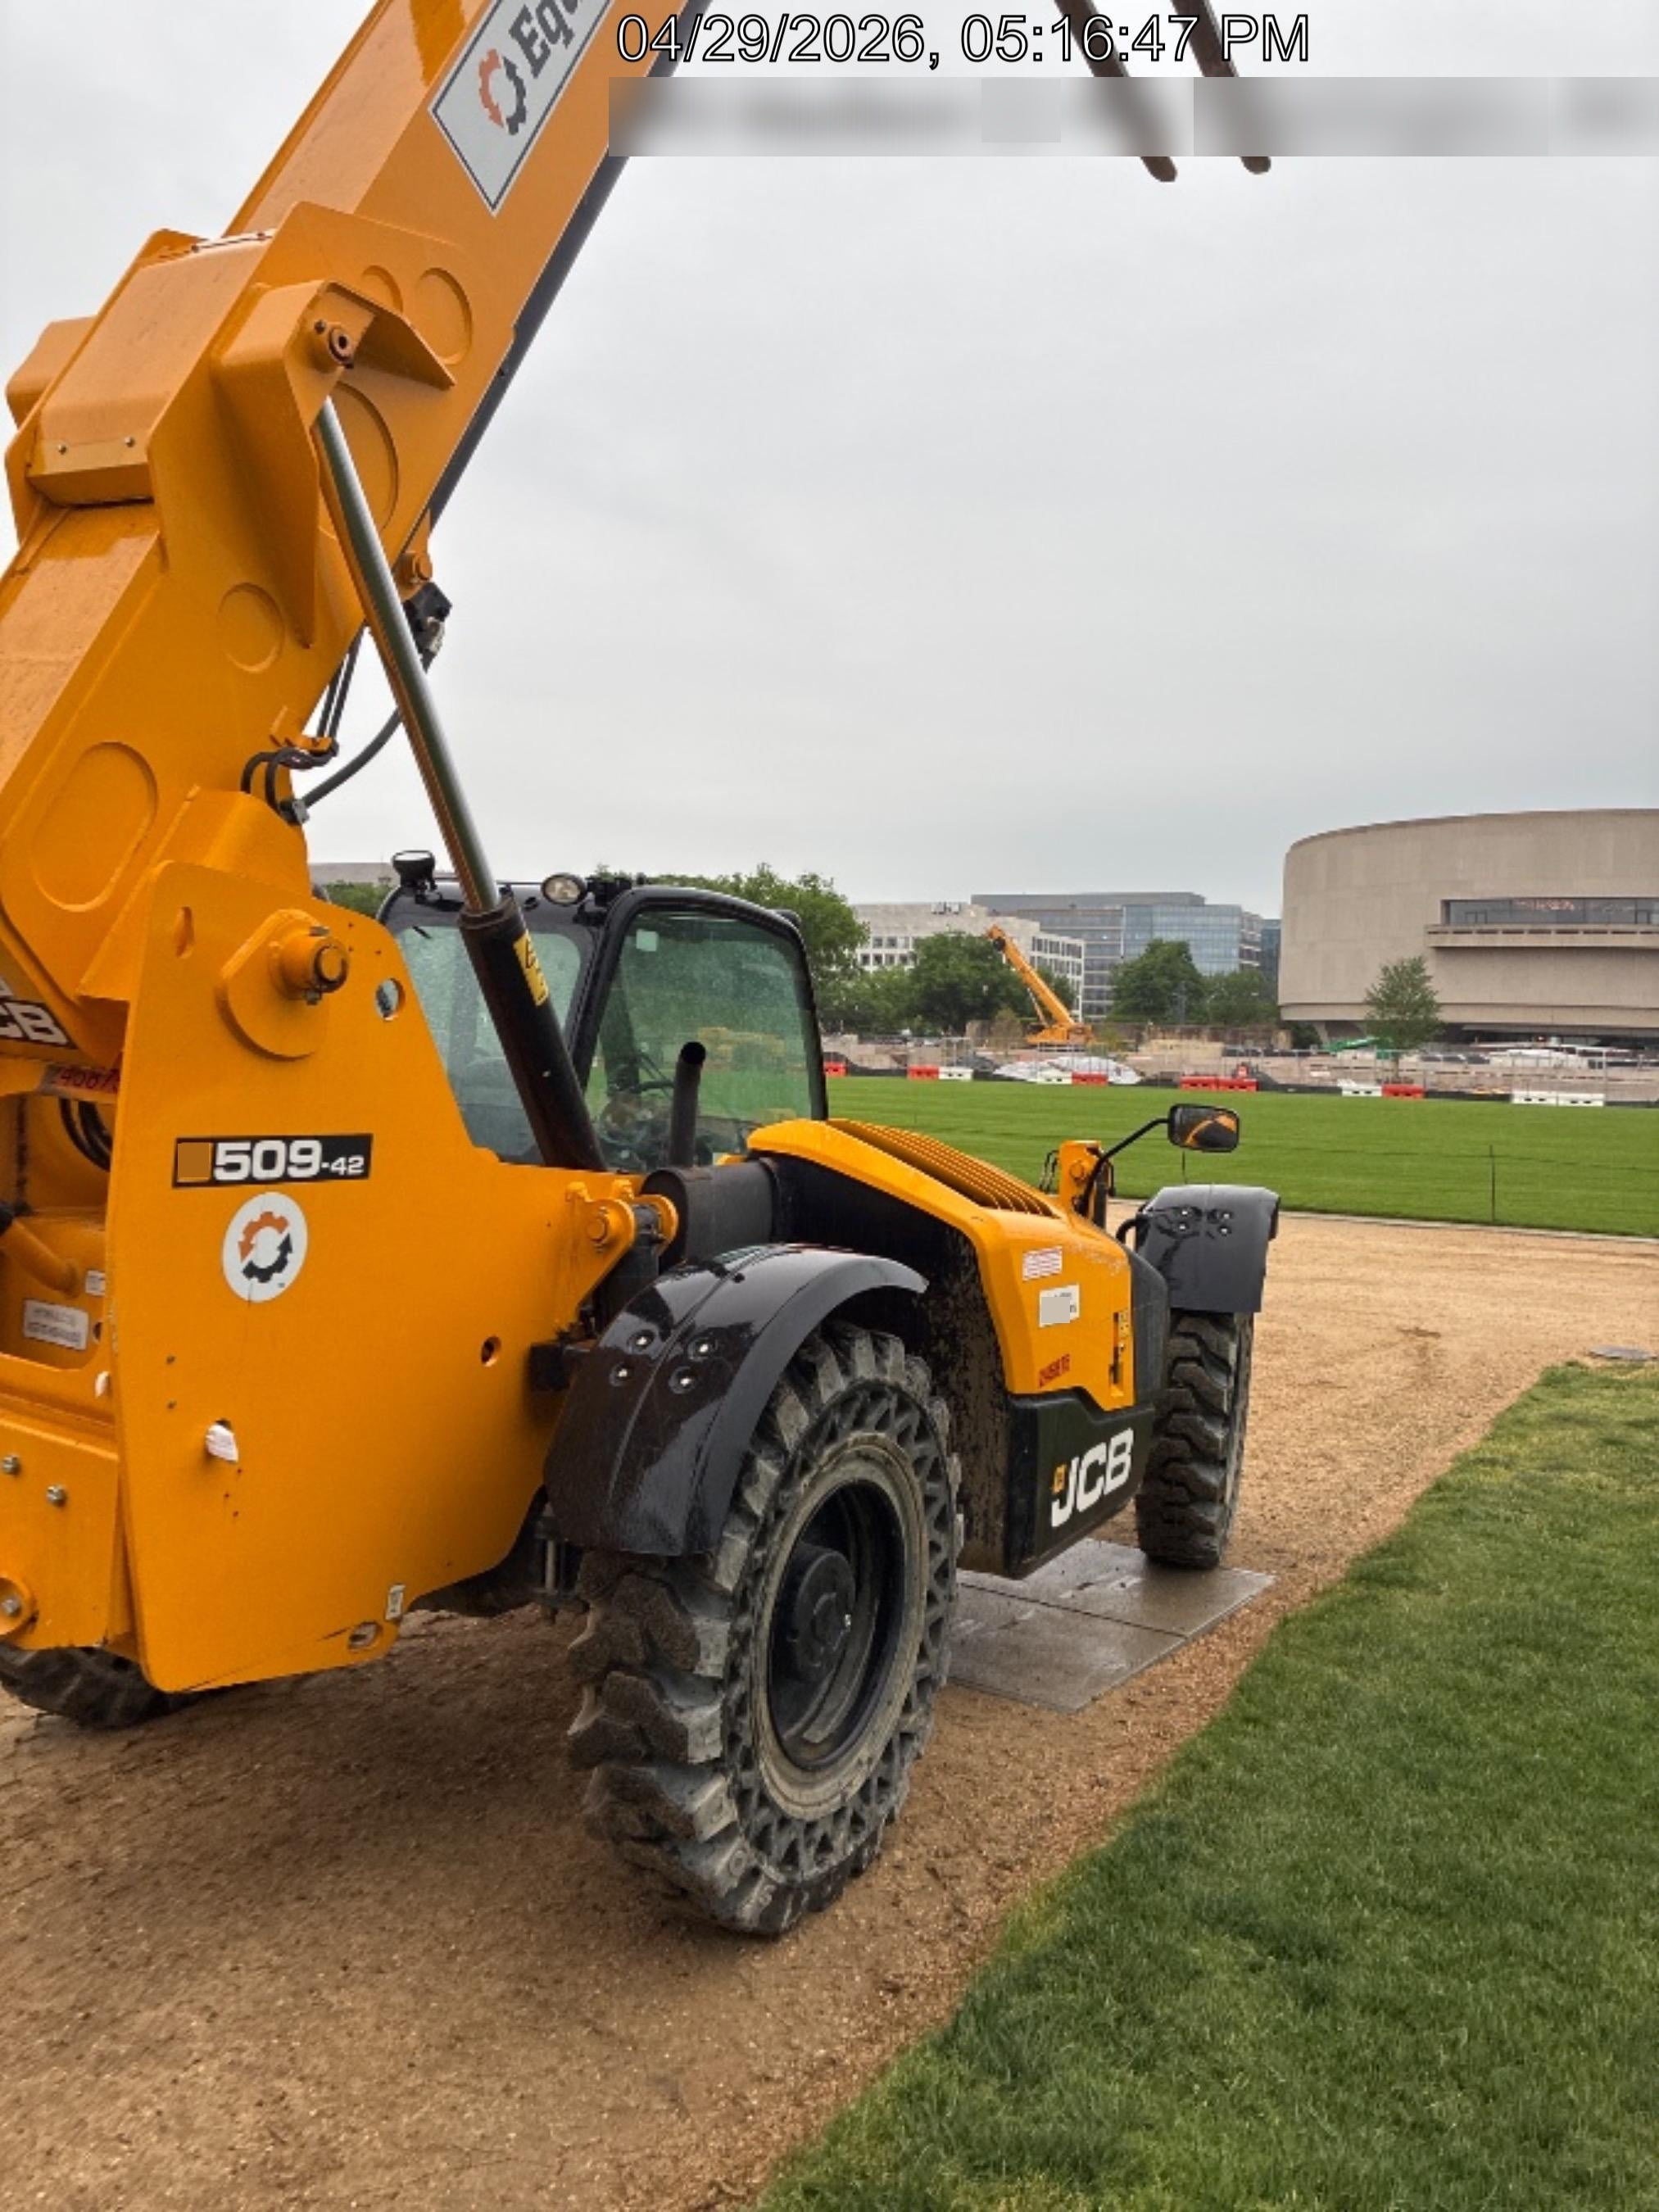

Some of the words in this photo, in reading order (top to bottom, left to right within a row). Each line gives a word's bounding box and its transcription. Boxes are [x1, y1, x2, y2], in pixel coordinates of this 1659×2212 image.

[508, 0, 578, 79] Eq
[213, 1139, 365, 1181] 509-42
[1051, 1426, 1134, 1527] JCB
